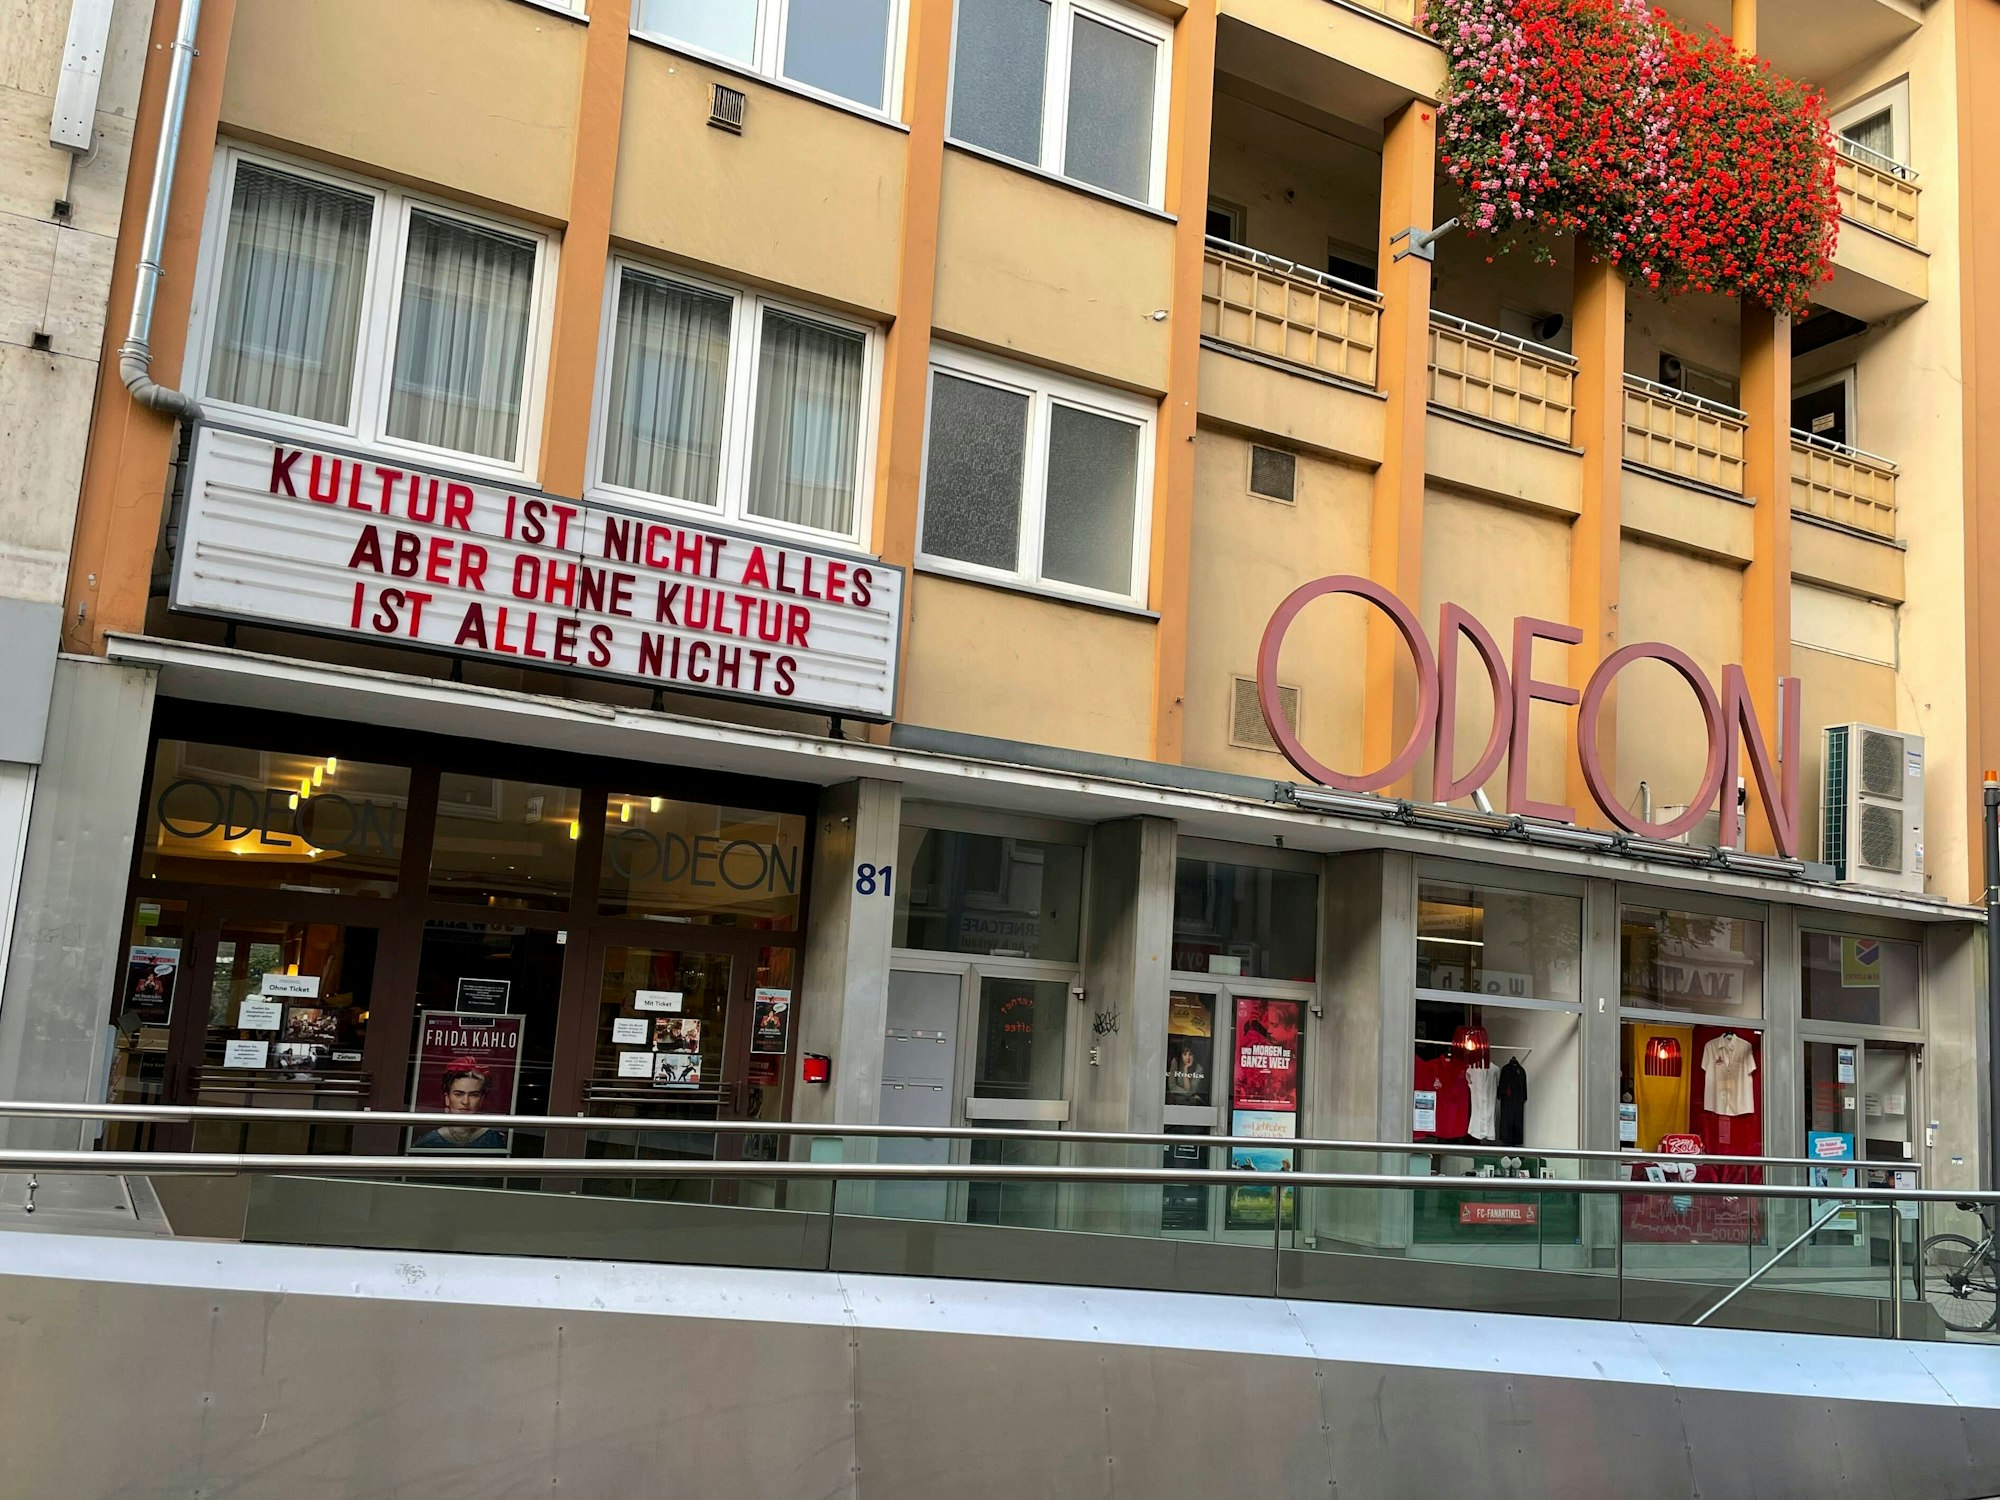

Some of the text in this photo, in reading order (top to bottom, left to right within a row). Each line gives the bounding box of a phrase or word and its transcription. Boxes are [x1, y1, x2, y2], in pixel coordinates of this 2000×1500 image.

[270, 447, 873, 608] KULTUR IST NICHT ALLES
[347, 525, 811, 648] ABER OHNE KULTUR
[350, 582, 798, 697] IST ALLES NICHTS
[1257, 574, 1801, 859] ODEON
[157, 779, 398, 856] ODEON
[610, 828, 798, 894] ODEON
[855, 863, 892, 897] 81
[289, 985, 310, 993] Ticket
[426, 1029, 517, 1049] FRIDA KAHLO
[1252, 1045, 1283, 1057] MORGEN
[1174, 1070, 1205, 1079] Rocks
[1240, 1055, 1291, 1070] GANZE WELT
[1476, 1208, 1522, 1219] FC-FANARTIKEL
[1711, 1228, 1759, 1241] COLONA
